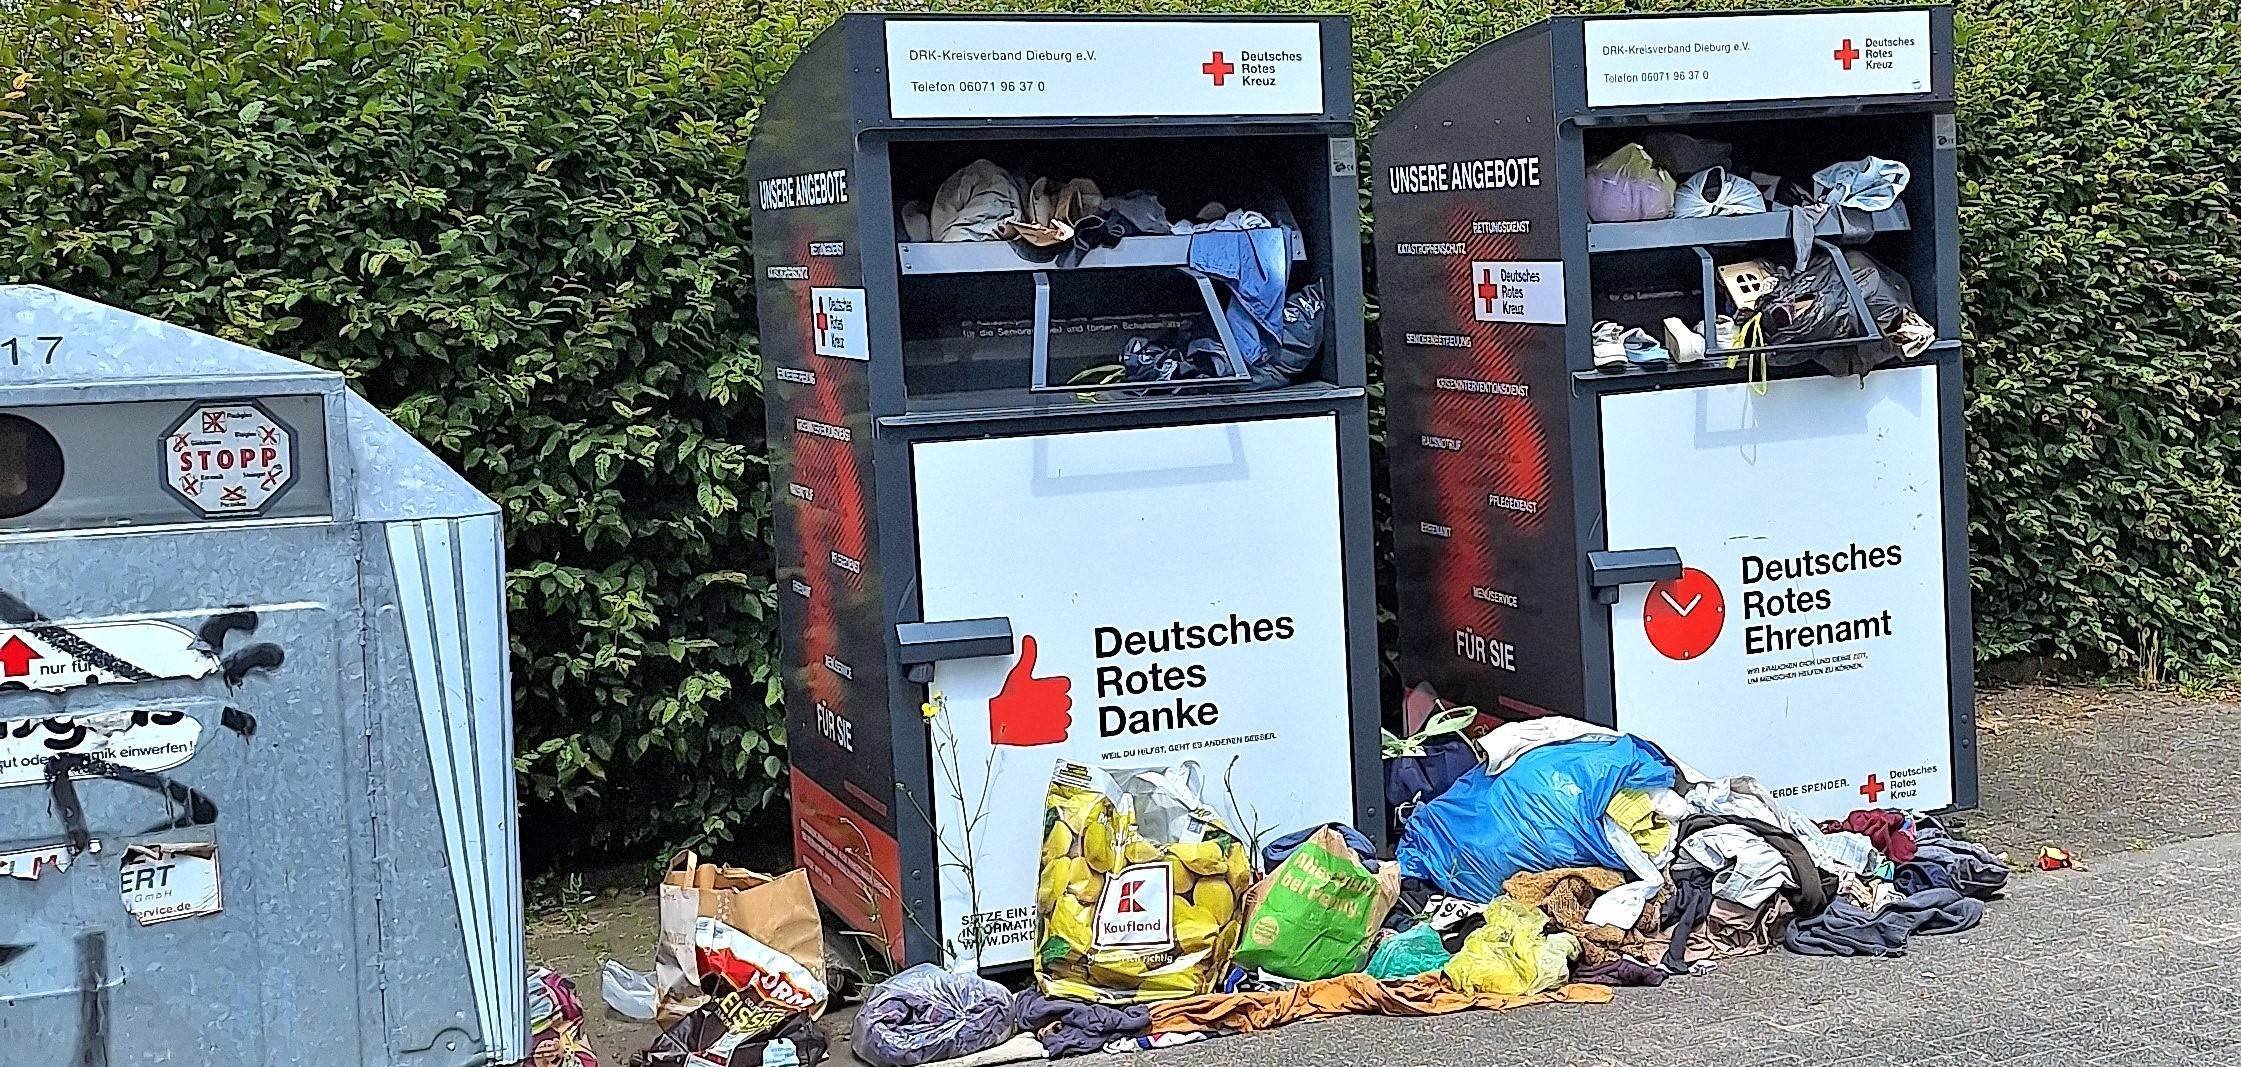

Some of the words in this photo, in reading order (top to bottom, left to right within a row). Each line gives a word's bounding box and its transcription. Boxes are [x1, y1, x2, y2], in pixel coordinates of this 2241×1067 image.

[1865, 37, 1915, 47] Deutsches
[1603, 43, 1691, 56] DRK-Kreisverband
[1694, 42, 1731, 54] Dieburg
[1865, 49, 1893, 58] Rotes
[909, 50, 1022, 61] DRK-Kreisverband
[1026, 50, 1072, 63] Dieburg
[1076, 50, 1097, 61] e.V.
[1241, 51, 1302, 62] Deutsches
[1242, 63, 1275, 74] Rotes
[1865, 60, 1893, 69] Kreuz
[1242, 75, 1276, 86] Kreuz
[1604, 73, 1638, 83] Telefon
[1641, 72, 1669, 82] 06071
[1673, 71, 1685, 81] 96
[1688, 71, 1699, 80] 37
[1702, 70, 1709, 80] 0
[911, 81, 955, 92] Telefon
[959, 81, 995, 92] 06071
[1000, 81, 1015, 92] 96
[1019, 81, 1033, 92] 37
[1038, 81, 1045, 92] 0
[1389, 163, 1449, 194] UNSERE
[1451, 156, 1541, 191] ANGEBOTE
[759, 177, 795, 210] UNSERE
[795, 169, 848, 207] ANGEBOTE
[1500, 269, 1541, 282] Deutsches
[1501, 285, 1524, 299] Rotes
[1502, 302, 1525, 315] Kreuz
[180, 447, 277, 471] STOPP
[1742, 543, 1902, 585] Deutsches
[1743, 587, 1832, 621] Rotes
[1094, 613, 1295, 660] Deutsches
[1744, 610, 1892, 655] Ehrenamt
[1456, 626, 1487, 664] FÜR
[1489, 639, 1516, 672] SIE
[40, 663, 67, 675] nur
[1096, 659, 1208, 698] Rotes
[1098, 697, 1220, 738] Danke
[816, 700, 837, 743] FÜR
[836, 714, 855, 753] SIE
[21, 755, 49, 767] ode
[1101, 751, 1122, 761] WEIL
[1124, 750, 1136, 758] DU
[1889, 764, 1938, 780] Deutsches
[1769, 785, 1799, 799] ERDE
[1801, 778, 1850, 794] SPENDER.
[1890, 779, 1917, 789] Rotes
[1891, 788, 1917, 800] Kreuz
[1006, 906, 1027, 919] EIN
[1104, 919, 1161, 935] Kaufland
[1142, 953, 1173, 964] richtig
